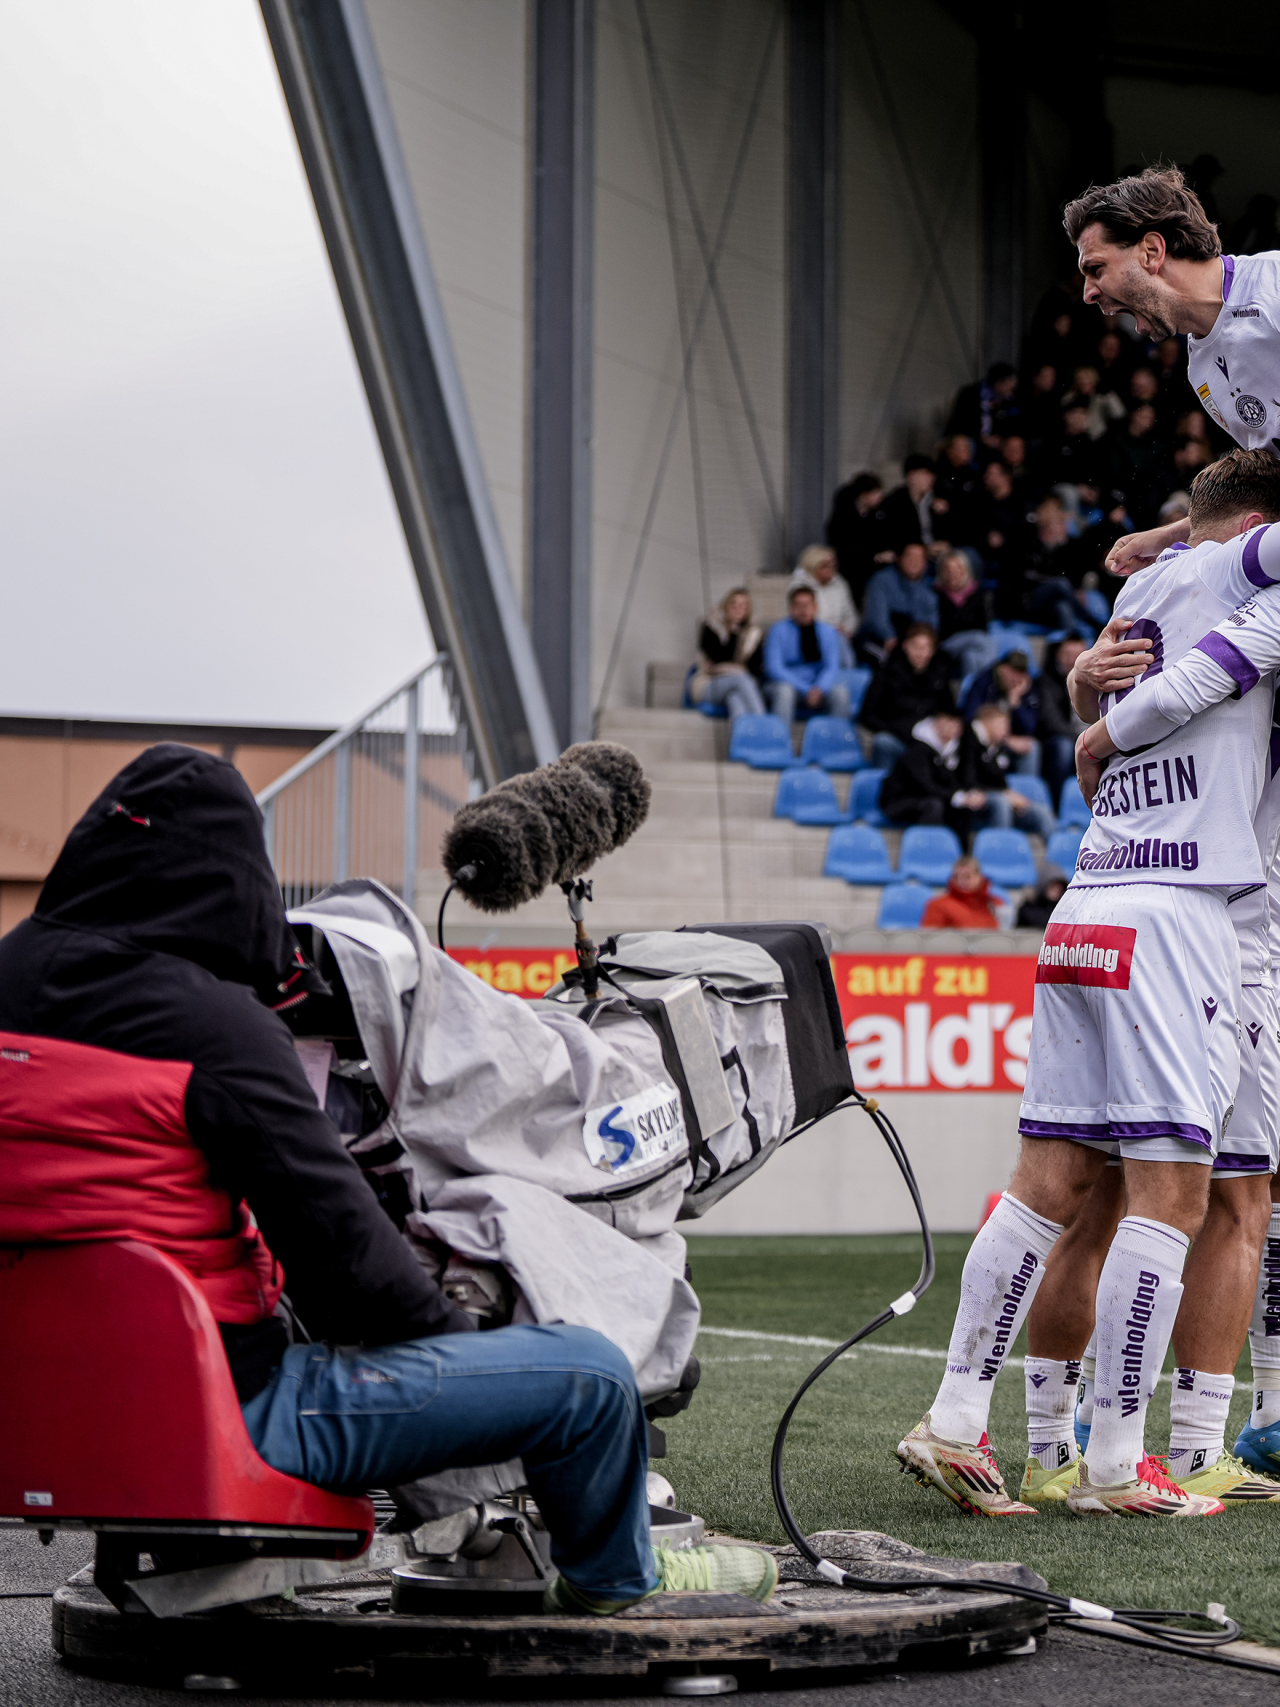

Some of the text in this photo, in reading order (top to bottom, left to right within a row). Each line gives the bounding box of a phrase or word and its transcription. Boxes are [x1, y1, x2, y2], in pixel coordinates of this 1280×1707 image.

[847, 957, 989, 997] auf zu
[1117, 1269, 1161, 1419] w!enhold!ng
